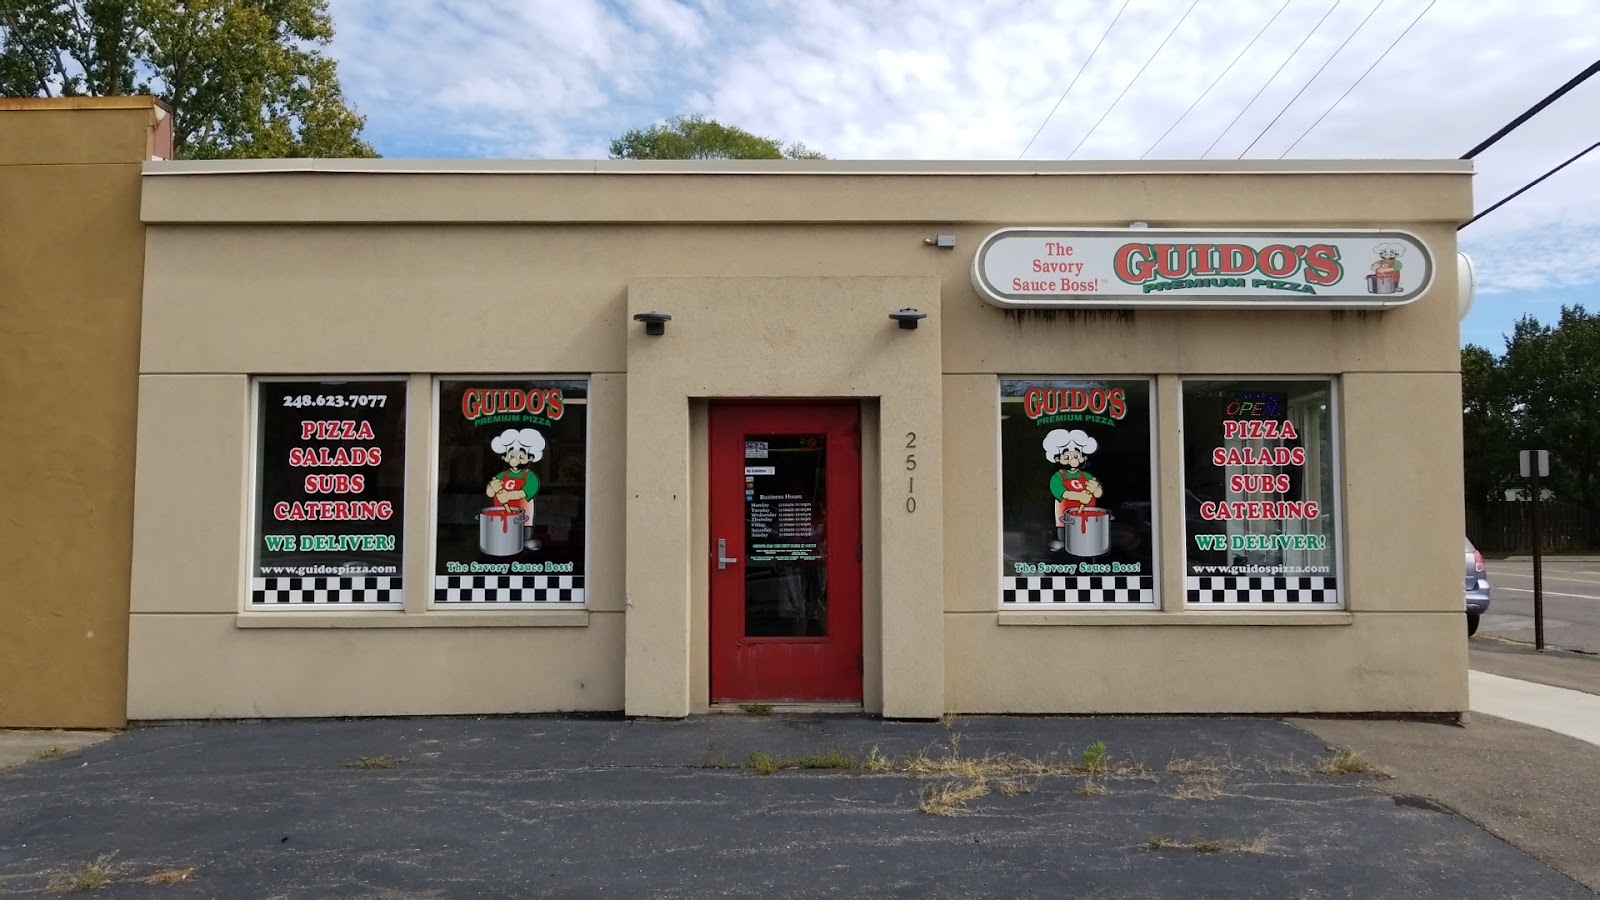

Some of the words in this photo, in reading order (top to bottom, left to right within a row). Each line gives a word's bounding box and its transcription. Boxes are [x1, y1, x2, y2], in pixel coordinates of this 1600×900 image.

[1046, 242, 1073, 256] The
[1032, 259, 1084, 276] Savory
[1114, 243, 1344, 286] GUIDO'S
[1012, 278, 1056, 291] Sauce
[1060, 278, 1098, 291] Boss!
[1143, 278, 1245, 294] PREMIUM
[1252, 279, 1316, 295] PIZZA
[283, 395, 387, 408] 248.623.7077
[462, 388, 564, 420] GUIDO'S
[1024, 388, 1127, 420] GUIDO'S
[1226, 402, 1277, 416] OPEN
[474, 415, 520, 427] PREMIUM
[522, 415, 552, 427] PIZZA
[1037, 414, 1082, 426] PREMIUM
[1085, 415, 1115, 427] PIZZA
[301, 421, 375, 440] PIZZA
[1224, 420, 1297, 439] PIZZA
[289, 448, 381, 466] SALADS
[1213, 447, 1305, 466] SALADS
[305, 474, 364, 494] SUBS
[1230, 474, 1290, 493] SUBS
[274, 501, 392, 520] CATERING
[1200, 501, 1320, 520] CATERING
[265, 535, 296, 551] WE
[300, 535, 396, 551] DELIVER!
[1195, 535, 1227, 550] WE
[1231, 535, 1326, 551] DELIVER!
[260, 565, 397, 576] www.guidospizza.com
[447, 562, 468, 572] The
[470, 562, 510, 574] Savory
[511, 562, 543, 572] Sauce
[544, 561, 573, 572] Boss!
[1014, 563, 1036, 573] The
[1037, 563, 1077, 574] Savory
[1079, 563, 1110, 573] Sauce
[1112, 562, 1141, 573] Boss!
[1192, 565, 1330, 576] www.guidospizza.com
